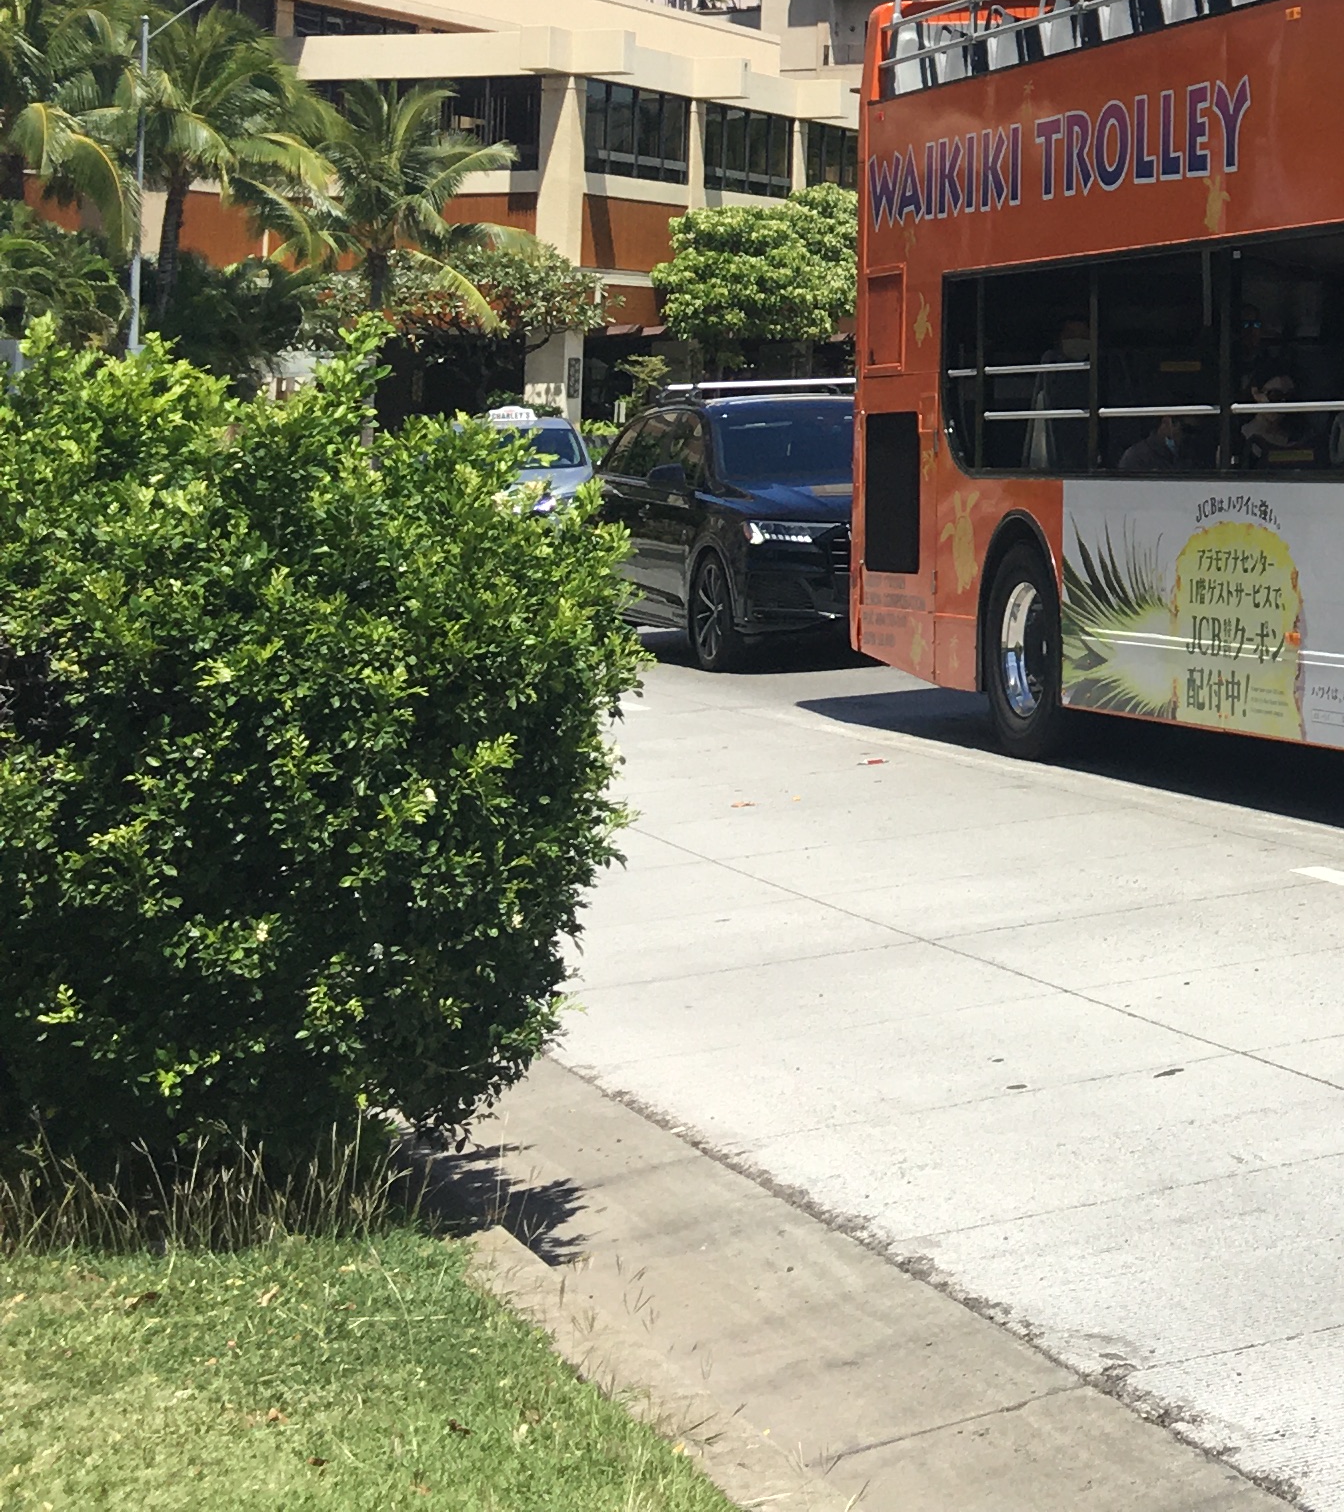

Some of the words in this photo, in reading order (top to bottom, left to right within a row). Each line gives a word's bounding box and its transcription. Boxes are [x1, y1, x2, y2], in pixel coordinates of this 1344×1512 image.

[868, 123, 1022, 233] WAIKIKI
[1034, 74, 1251, 200] TROLLEY
[1197, 548, 1275, 576] アラモアナセンター
